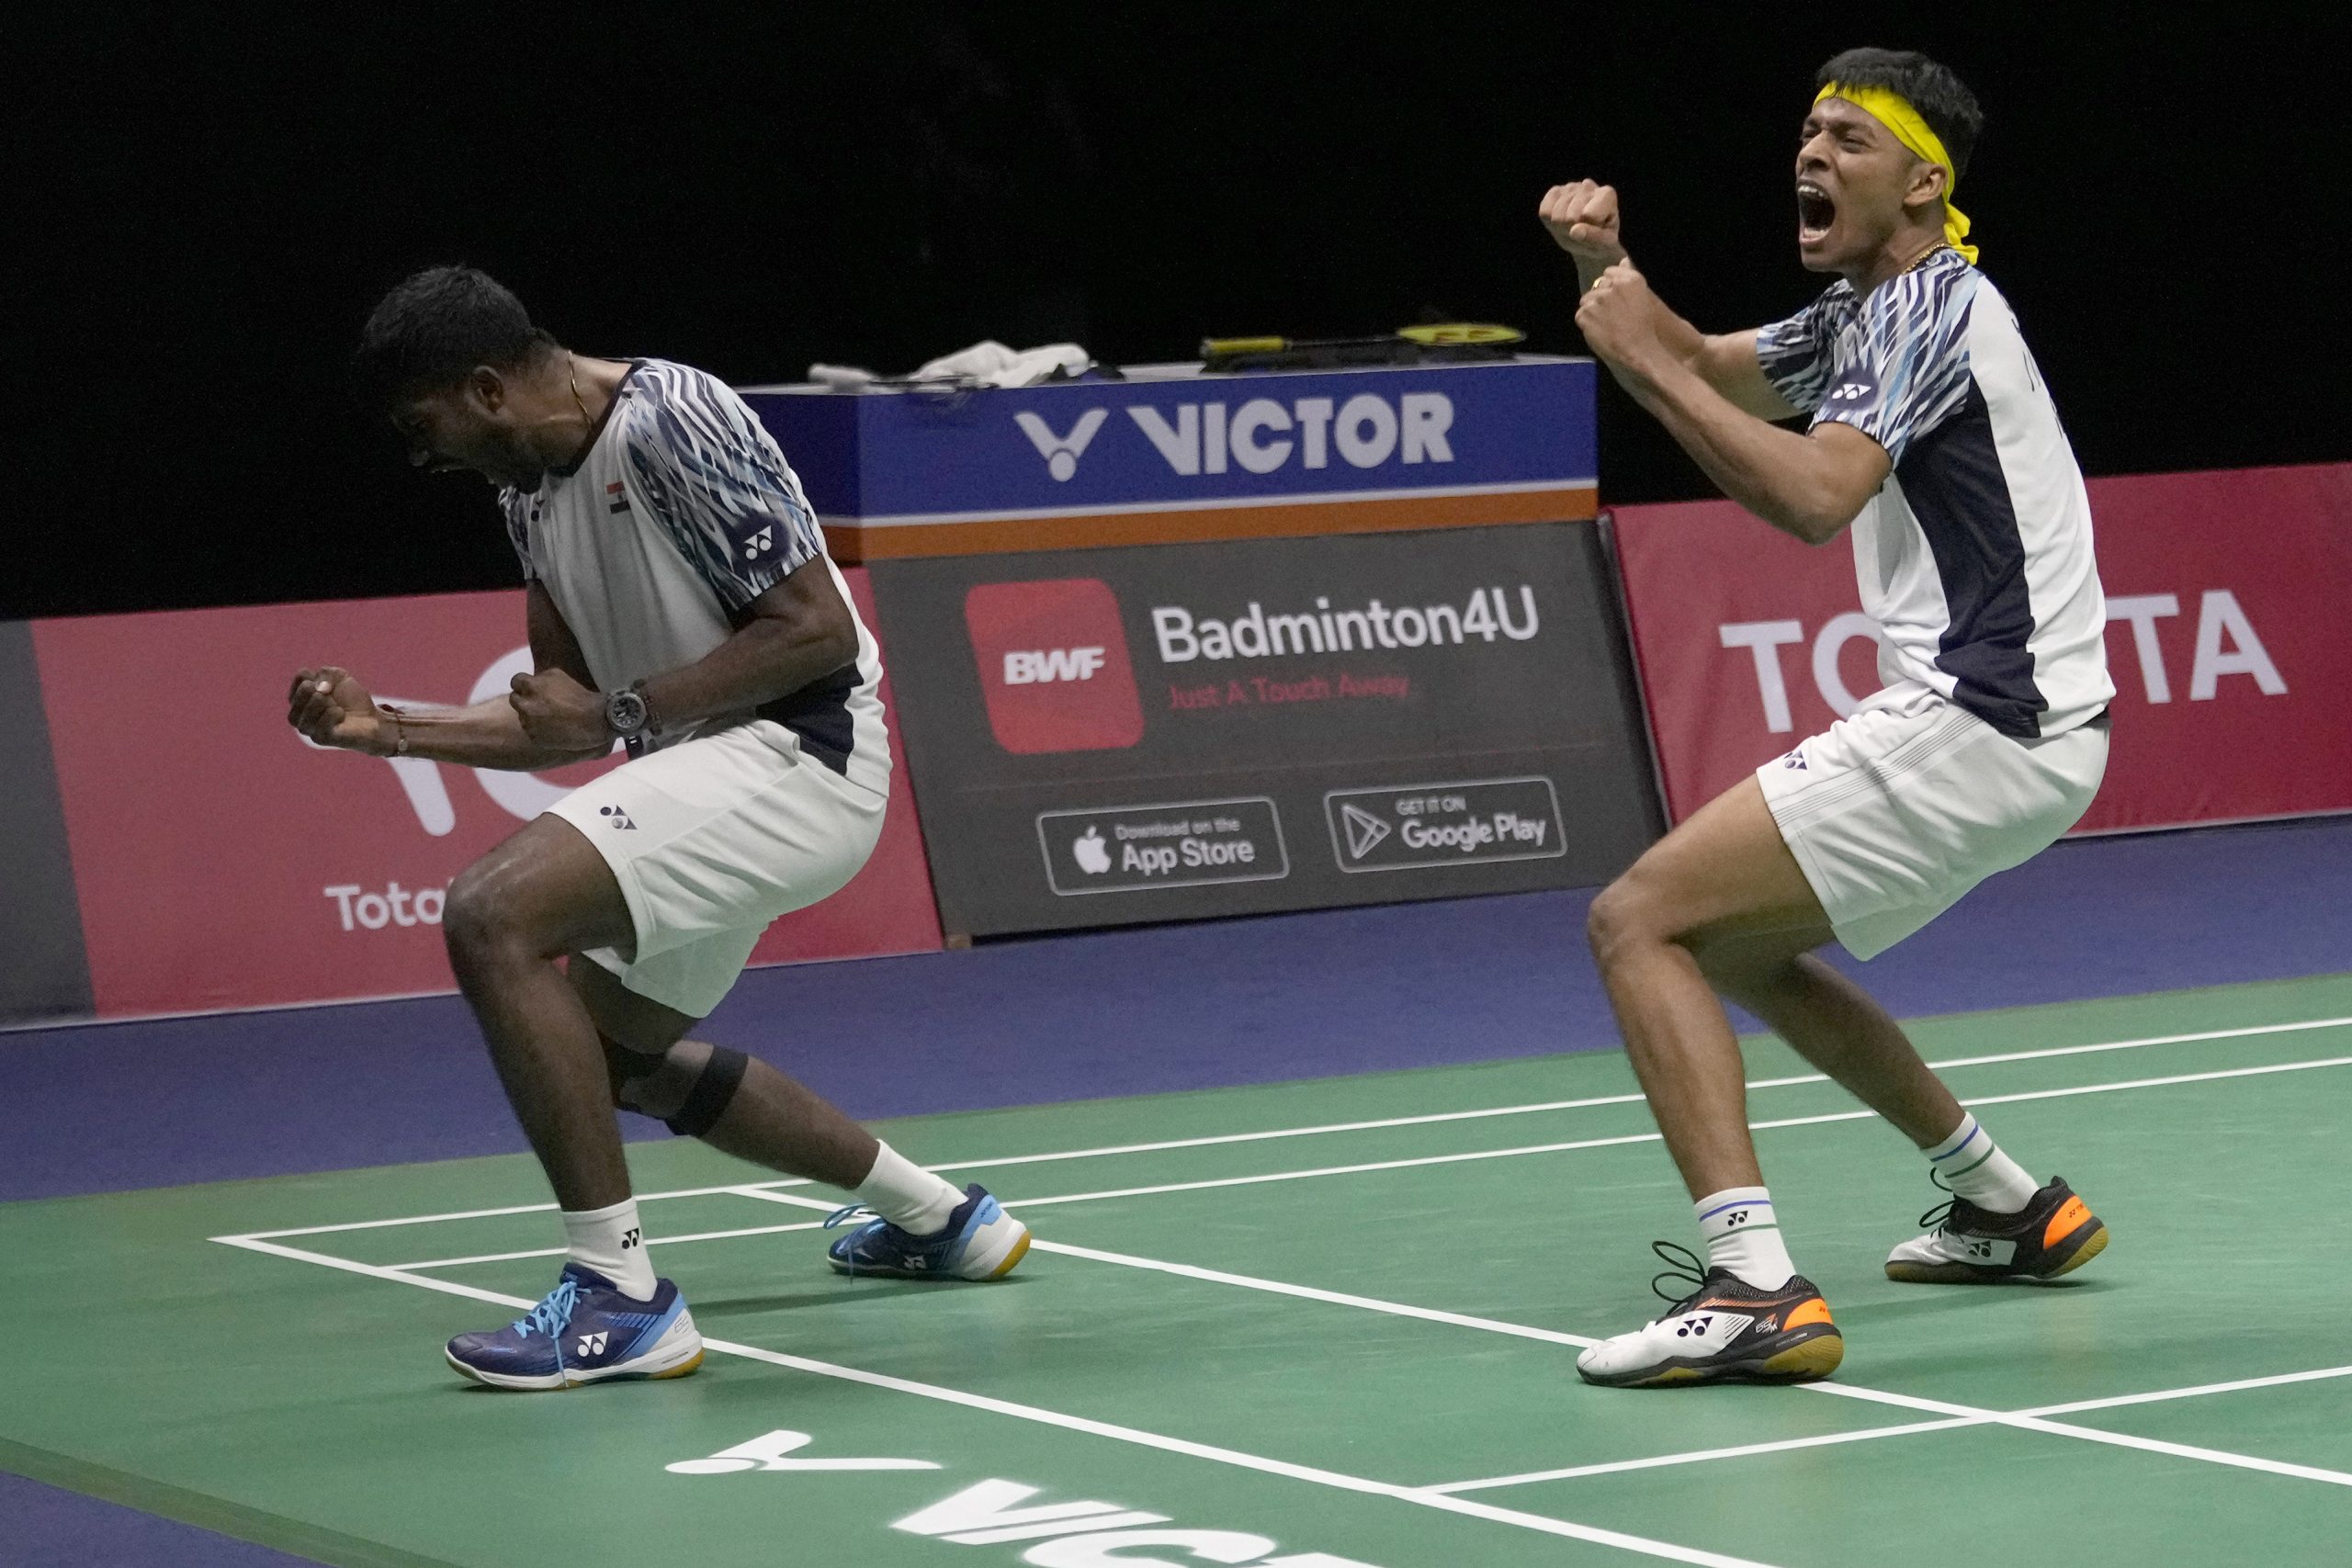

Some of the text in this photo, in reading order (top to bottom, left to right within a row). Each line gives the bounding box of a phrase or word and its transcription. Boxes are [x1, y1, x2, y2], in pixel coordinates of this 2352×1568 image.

[1125, 392, 1454, 476] VICTOR
[1151, 583, 1541, 663] Badminton4U
[1003, 646, 1105, 685] BWF
[1719, 590, 2289, 733] TOTA
[1169, 671, 1409, 710] Just A Touch Away
[1395, 797, 1424, 816] GET
[1441, 795, 1467, 813] ON
[1114, 819, 1190, 840] Download
[1400, 811, 1546, 852] Google Play
[1122, 837, 1256, 876] App Store
[323, 876, 455, 931] Tota
[888, 1477, 1381, 1568] VIC
